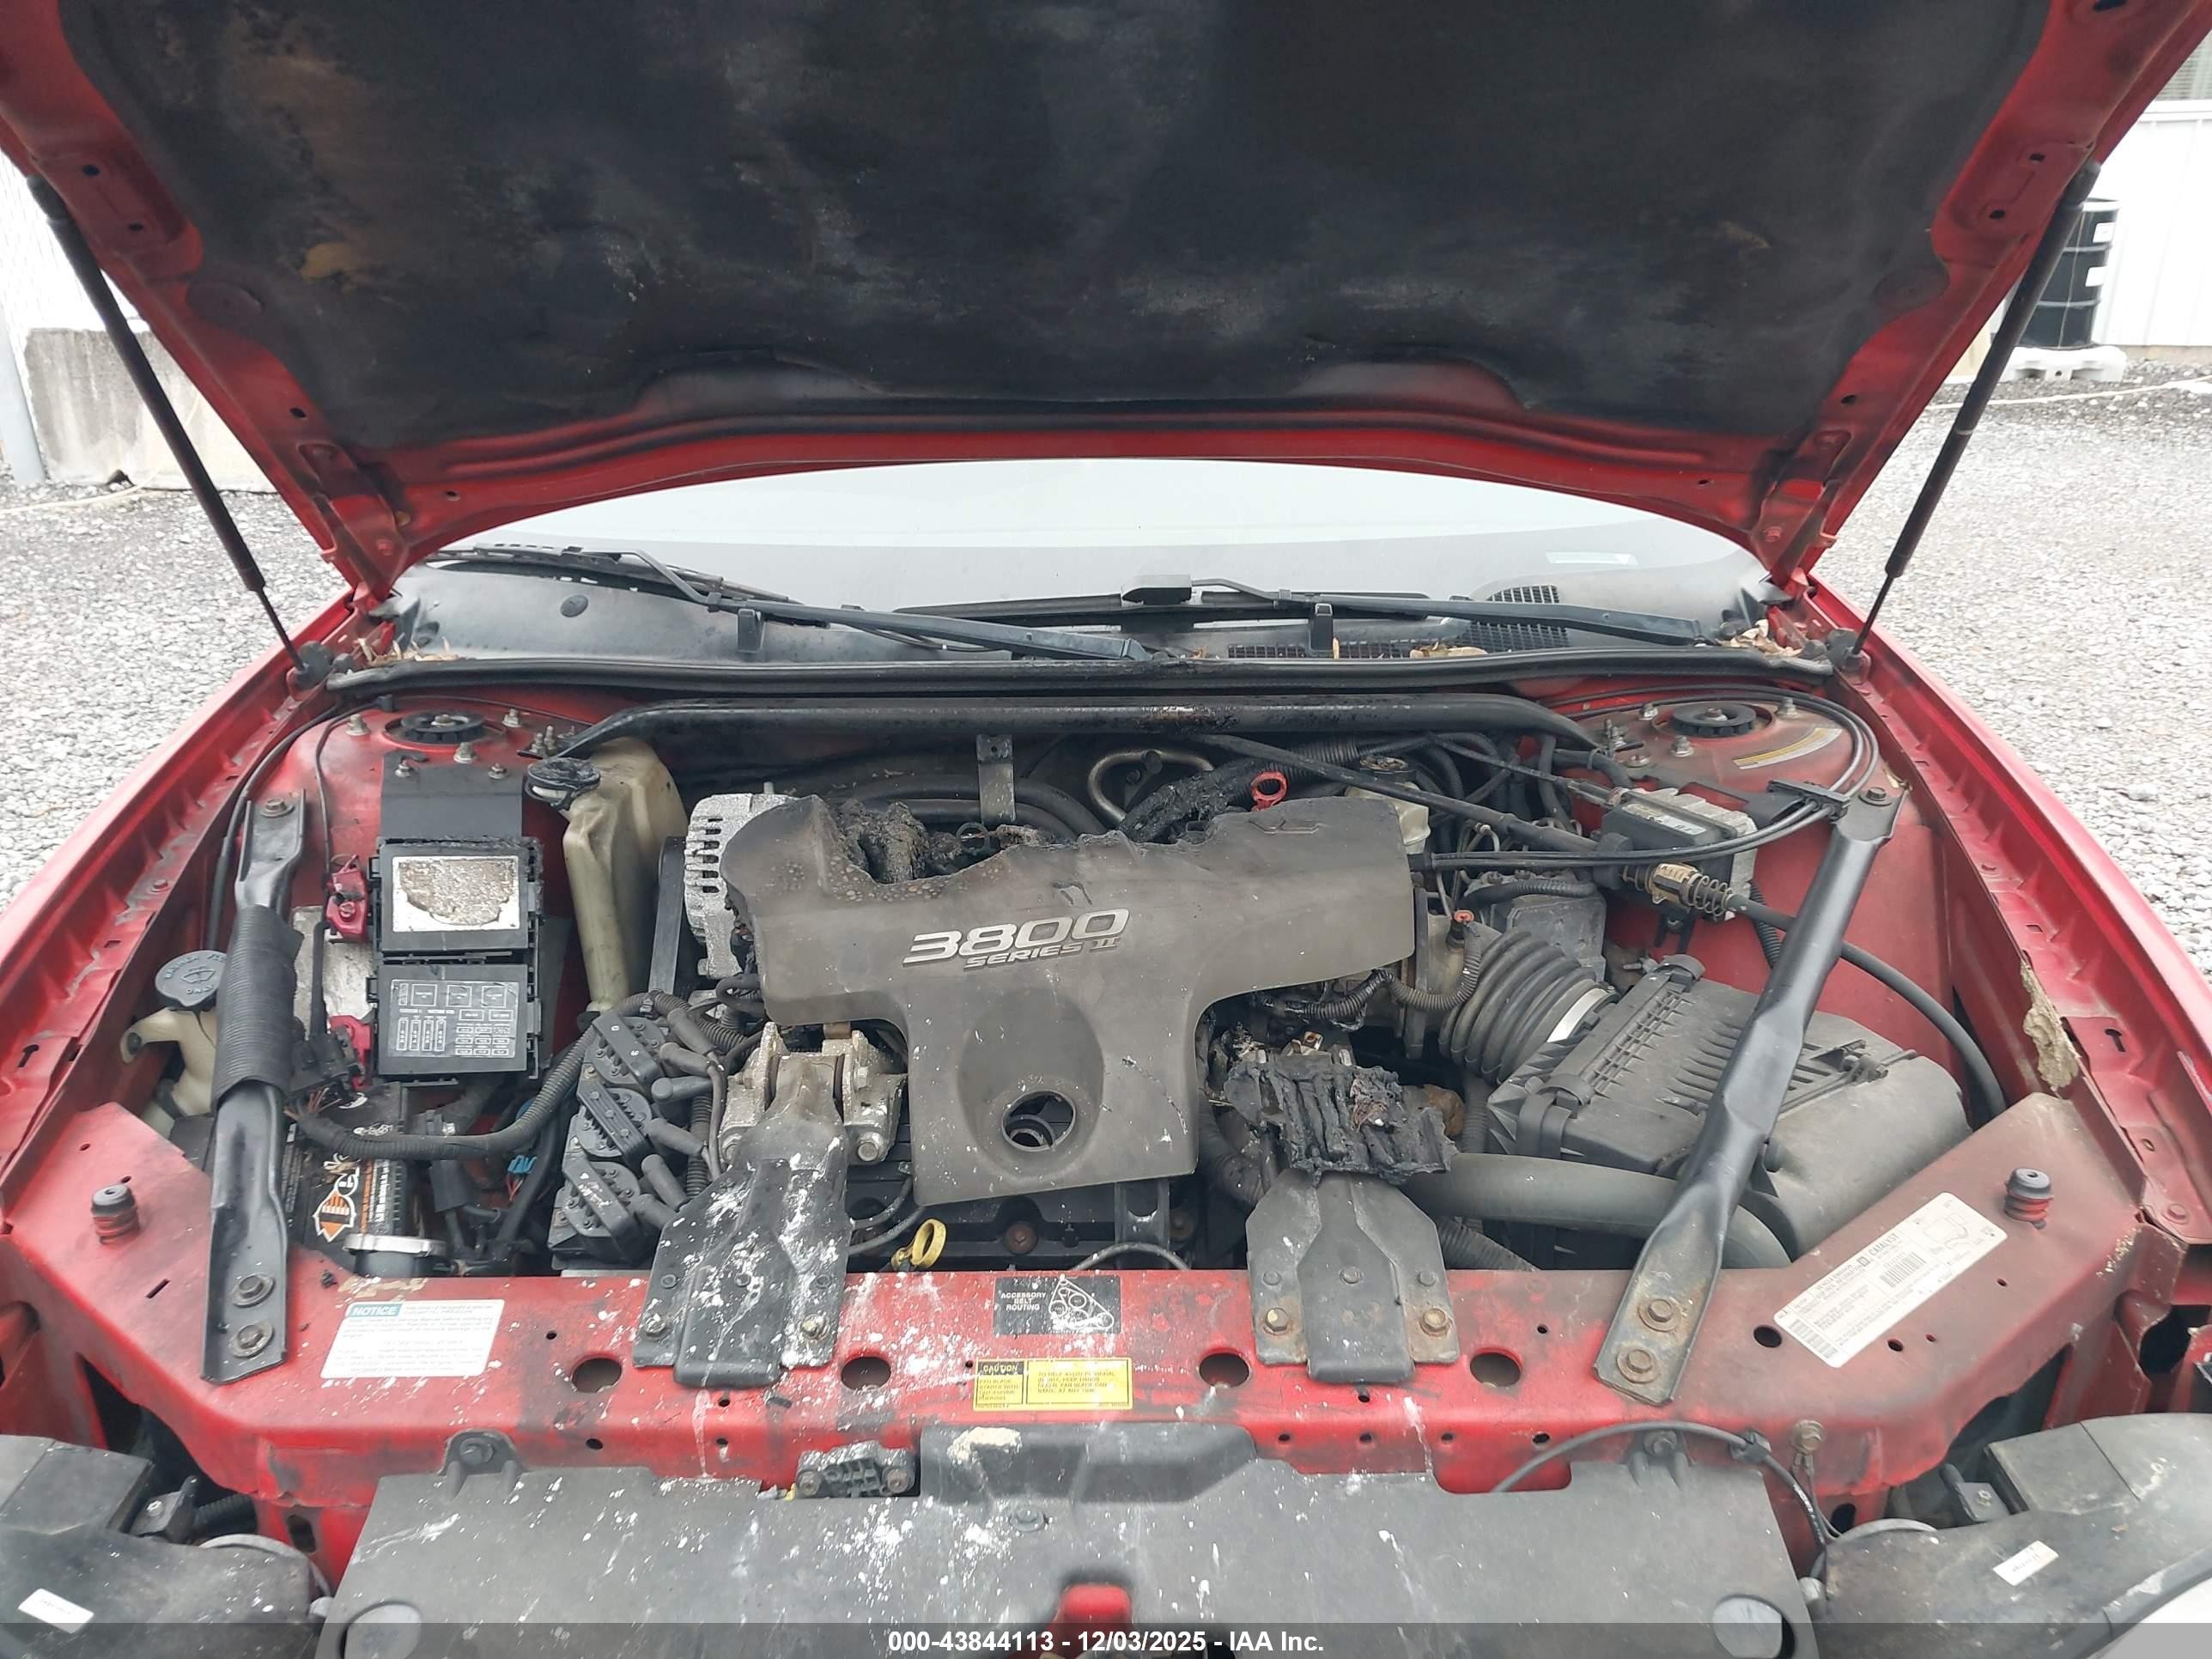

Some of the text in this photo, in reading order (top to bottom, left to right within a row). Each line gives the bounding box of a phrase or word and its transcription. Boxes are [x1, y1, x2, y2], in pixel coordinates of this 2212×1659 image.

[902, 908, 1130, 966] 3800
[963, 937, 1121, 970] SERIES II
[353, 1306, 397, 1316] NOTICE
[983, 1364, 1018, 1373] CAUTION
